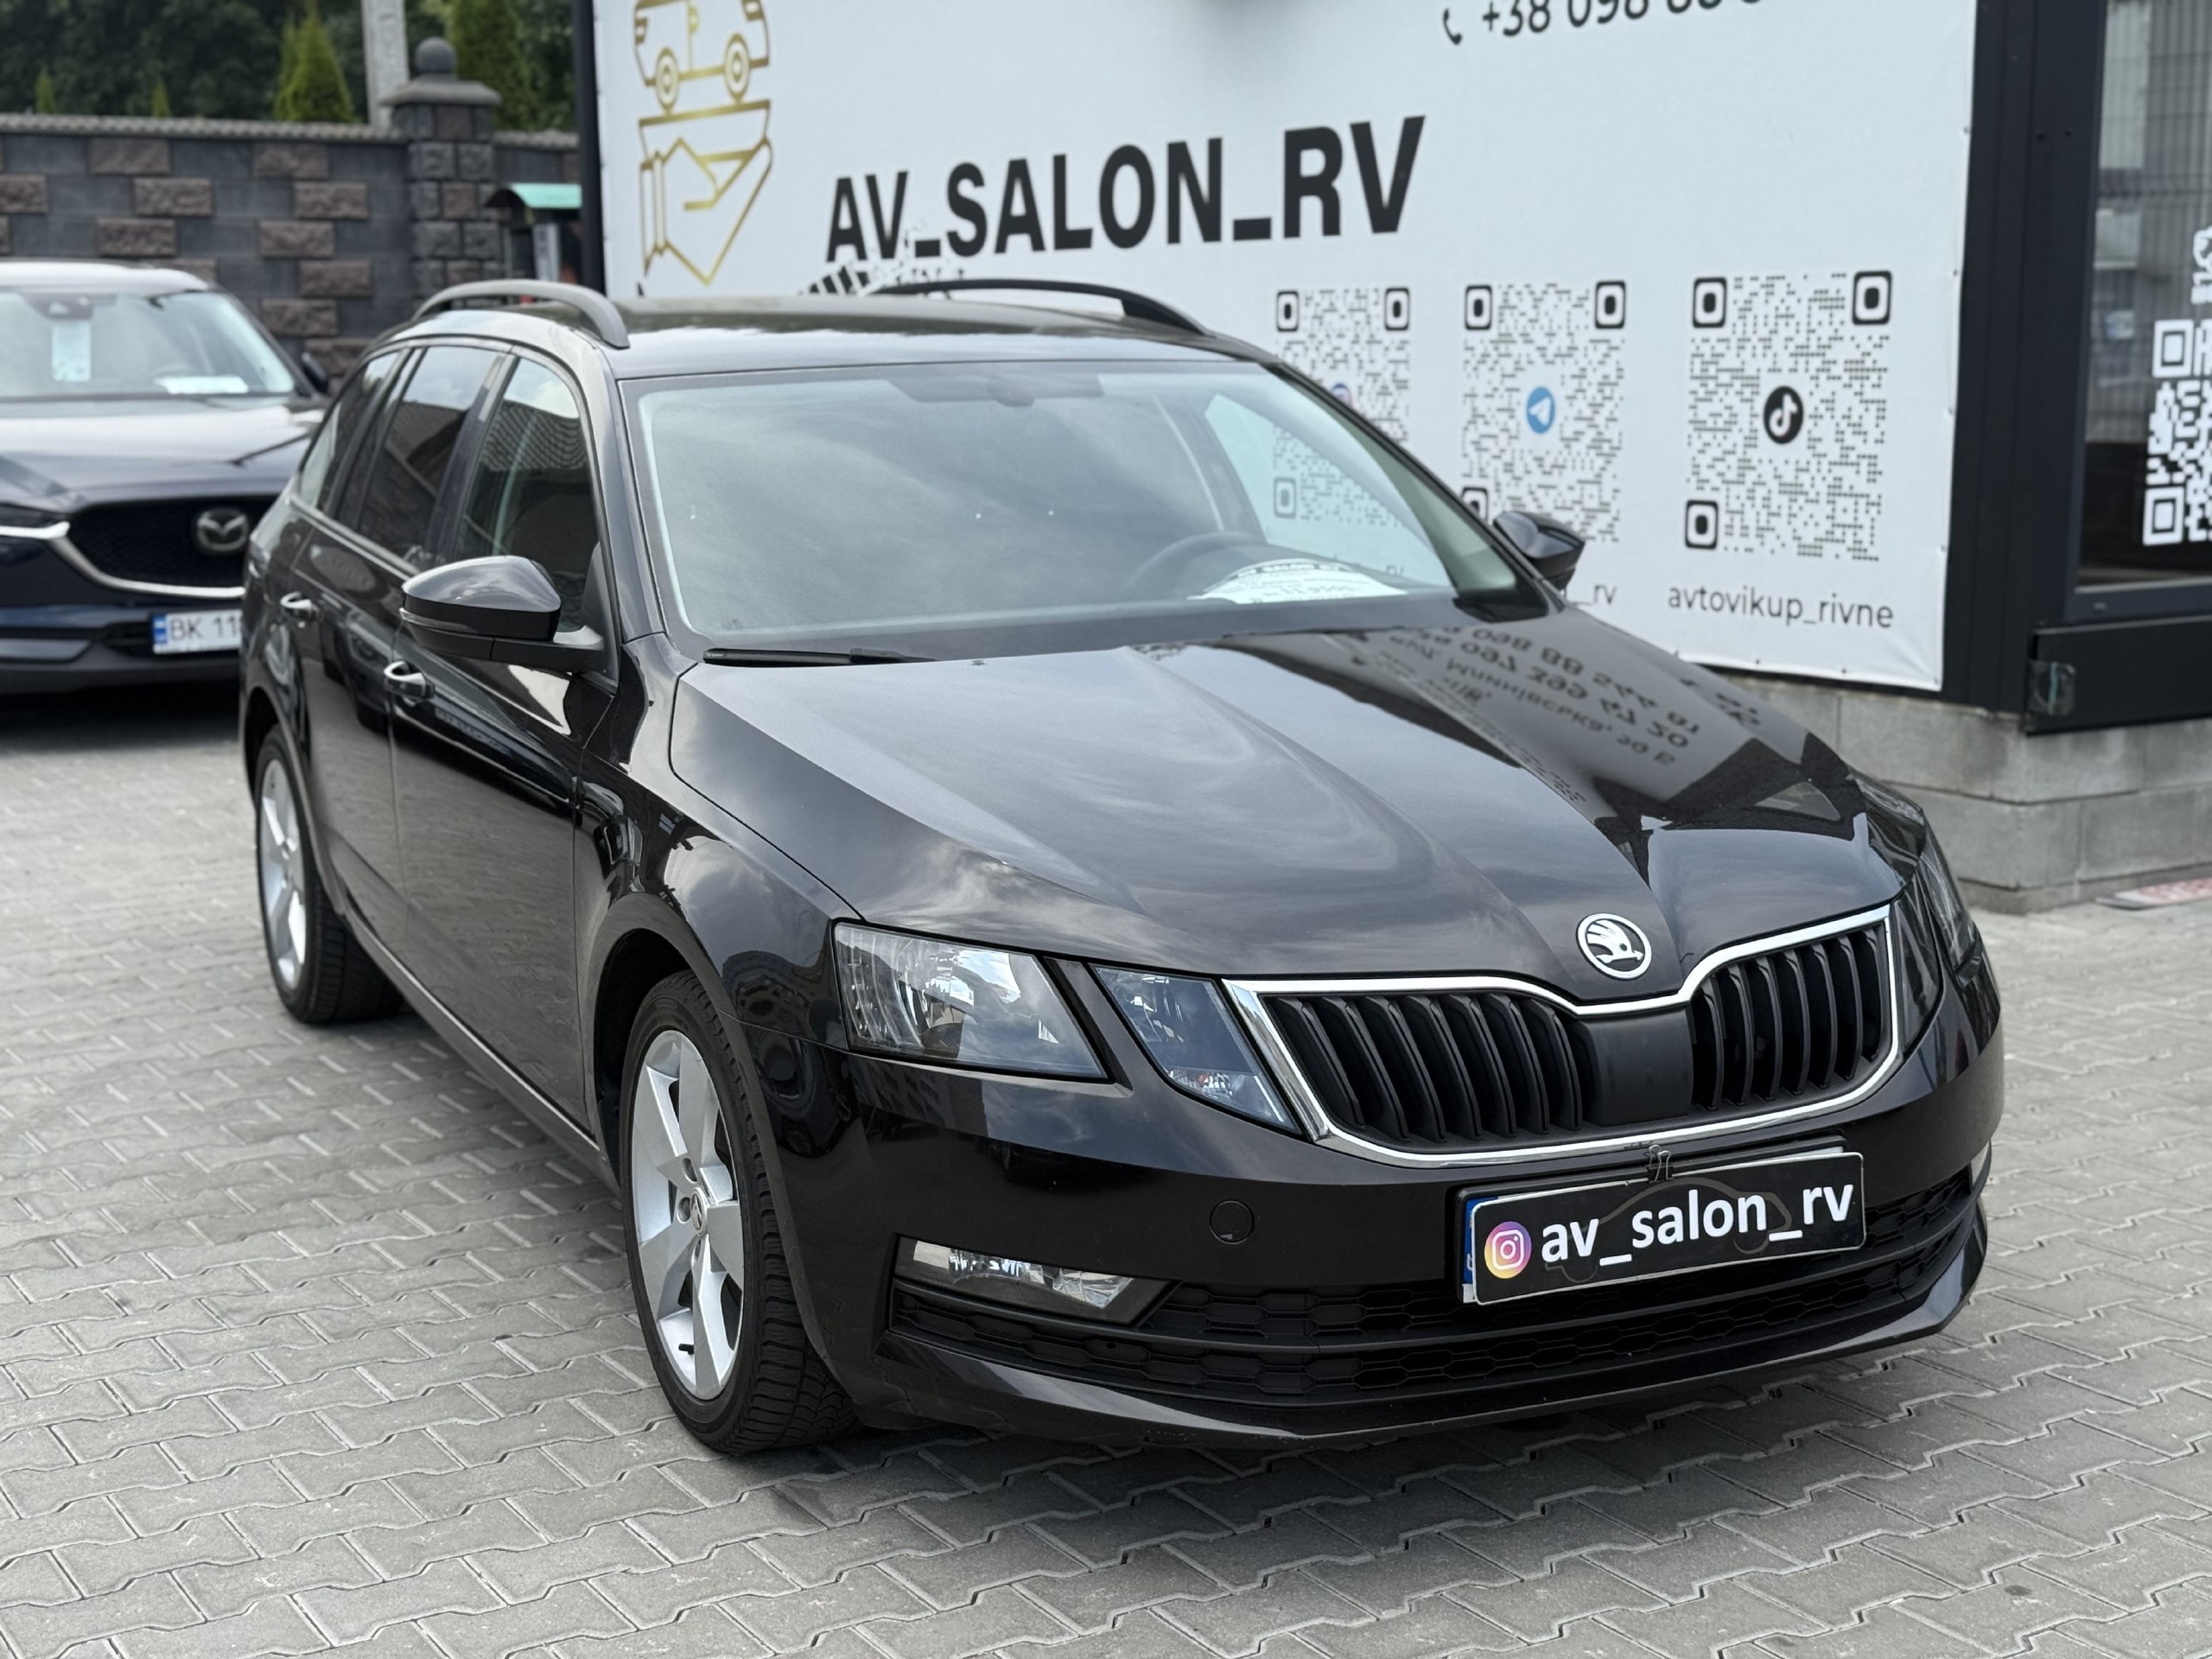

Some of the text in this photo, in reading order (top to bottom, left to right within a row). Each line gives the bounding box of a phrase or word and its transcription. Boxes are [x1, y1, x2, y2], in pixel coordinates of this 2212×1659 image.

[1483, 0, 1551, 37] +38
[827, 116, 1427, 262] AV_SALON_RV
[1668, 585, 1894, 628] avtovikup_rivne
[1541, 1184, 1854, 1268] av_salon_rv
